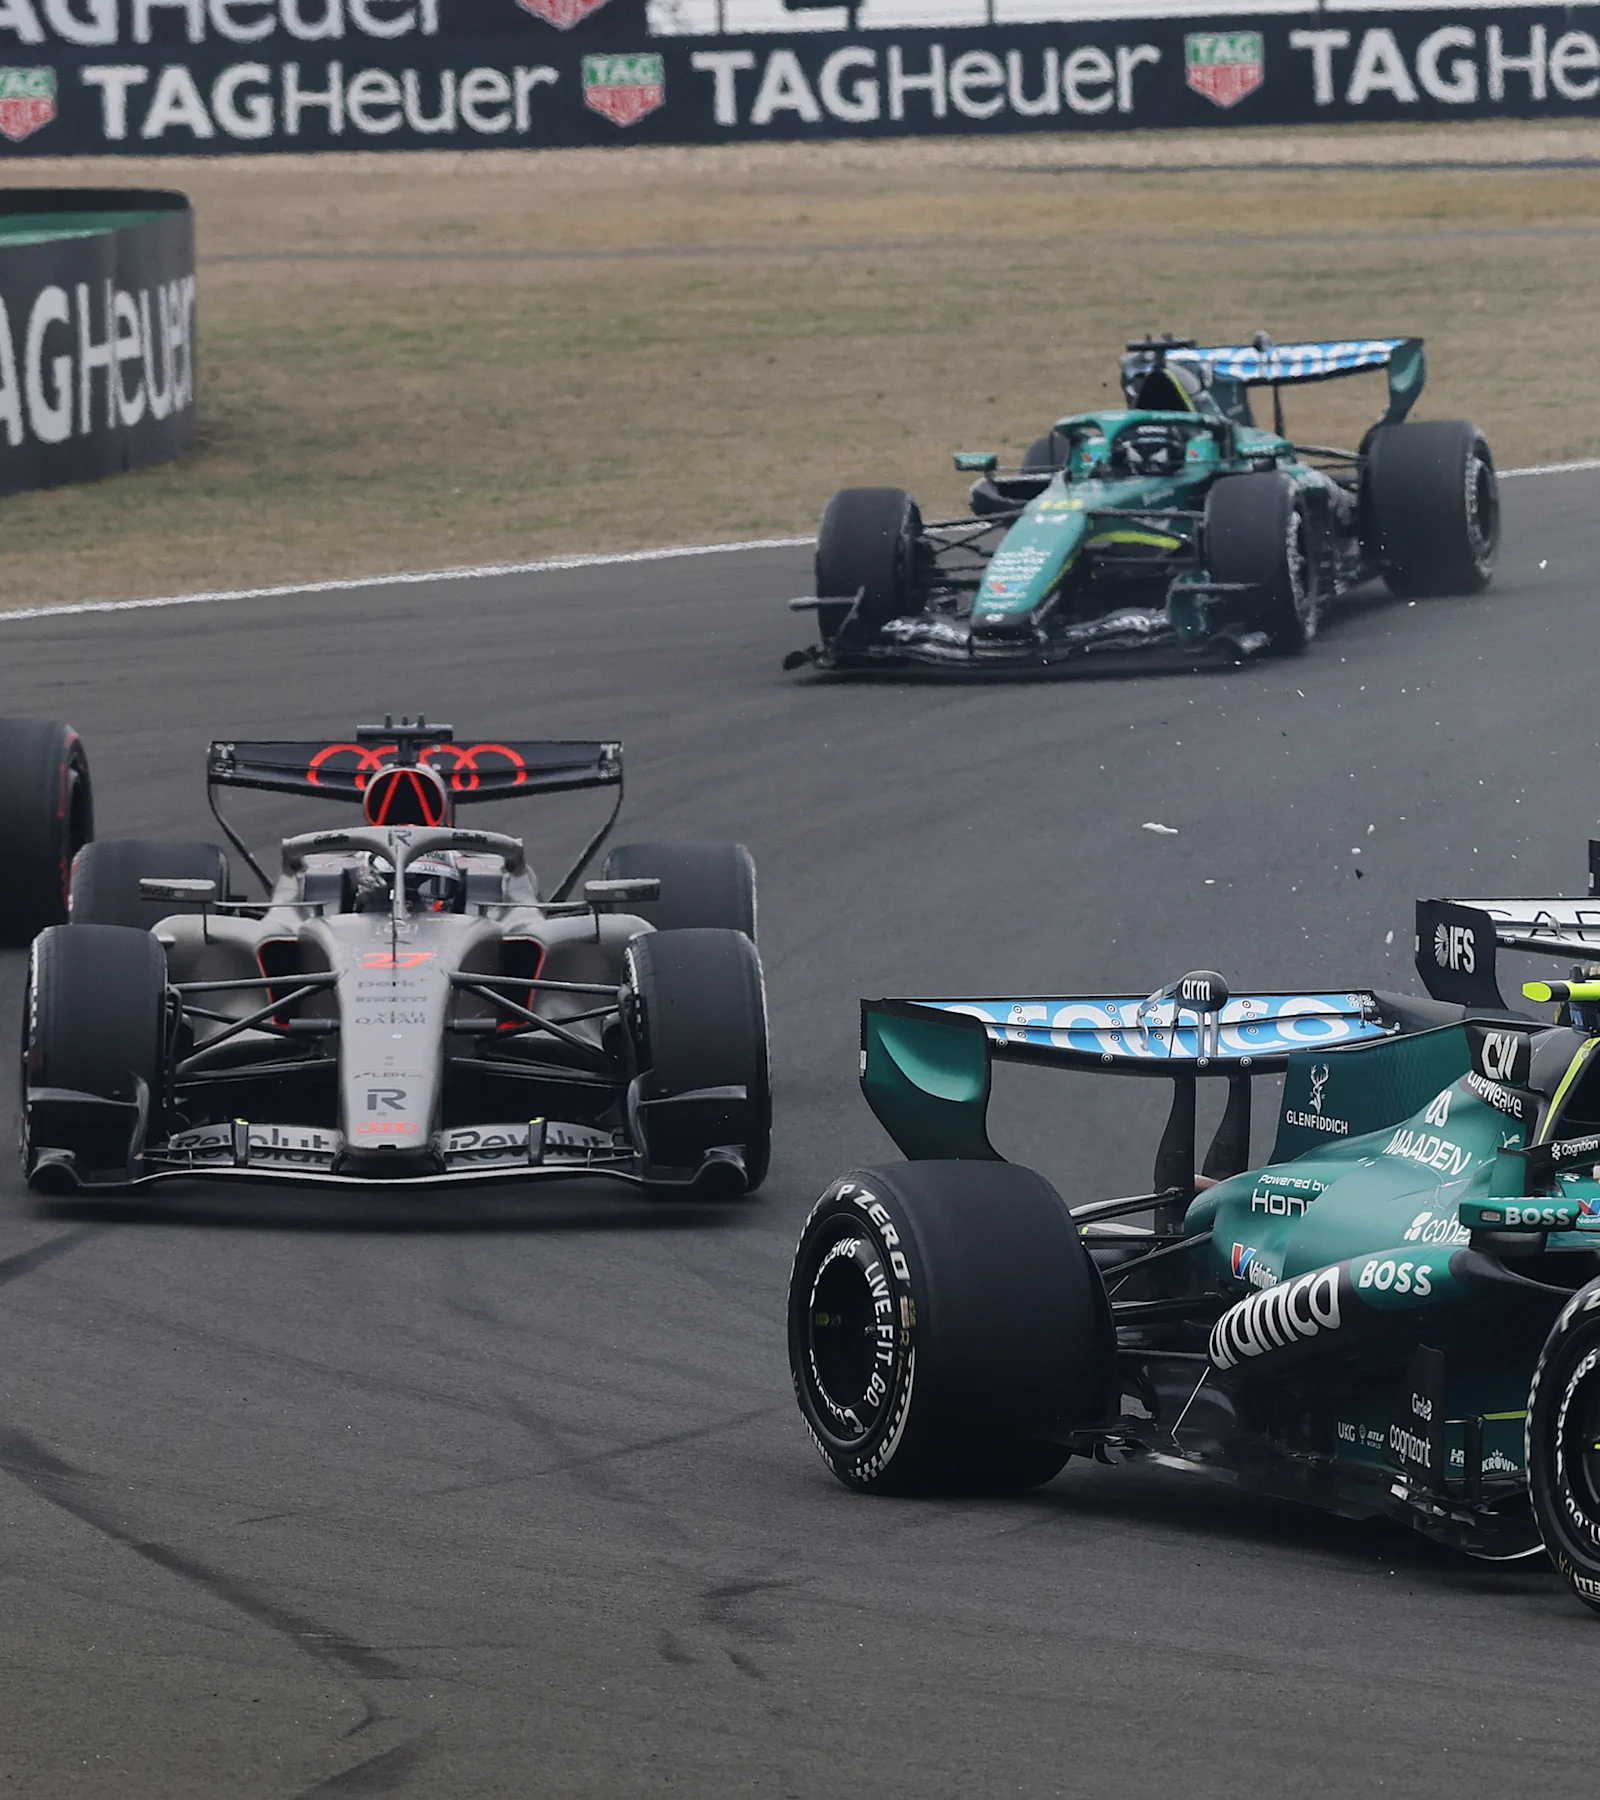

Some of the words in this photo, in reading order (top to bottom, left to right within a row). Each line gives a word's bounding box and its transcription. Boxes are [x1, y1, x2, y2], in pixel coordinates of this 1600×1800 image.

[360, 953, 436, 969] 27
[1449, 925, 1476, 973] IFS
[1182, 978, 1210, 1001] arm
[1286, 1110, 1348, 1135] GLENFIDDICH
[1382, 1129, 1472, 1175] MAADEN
[1560, 1139, 1599, 1158] Cognition
[1258, 1174, 1309, 1190] Powered
[1312, 1179, 1330, 1193] by
[1252, 1188, 1315, 1217] Hon
[1505, 1207, 1570, 1226] BOSS
[835, 1184, 856, 1201] P
[853, 1189, 911, 1280] ZERO
[1421, 1212, 1472, 1243] cohe
[1359, 1260, 1432, 1296] BOSS
[1209, 1266, 1341, 1370] aramco
[1560, 1299, 1580, 1333] P
[1338, 1421, 1355, 1442] UKG
[1389, 1424, 1431, 1468] cognizant
